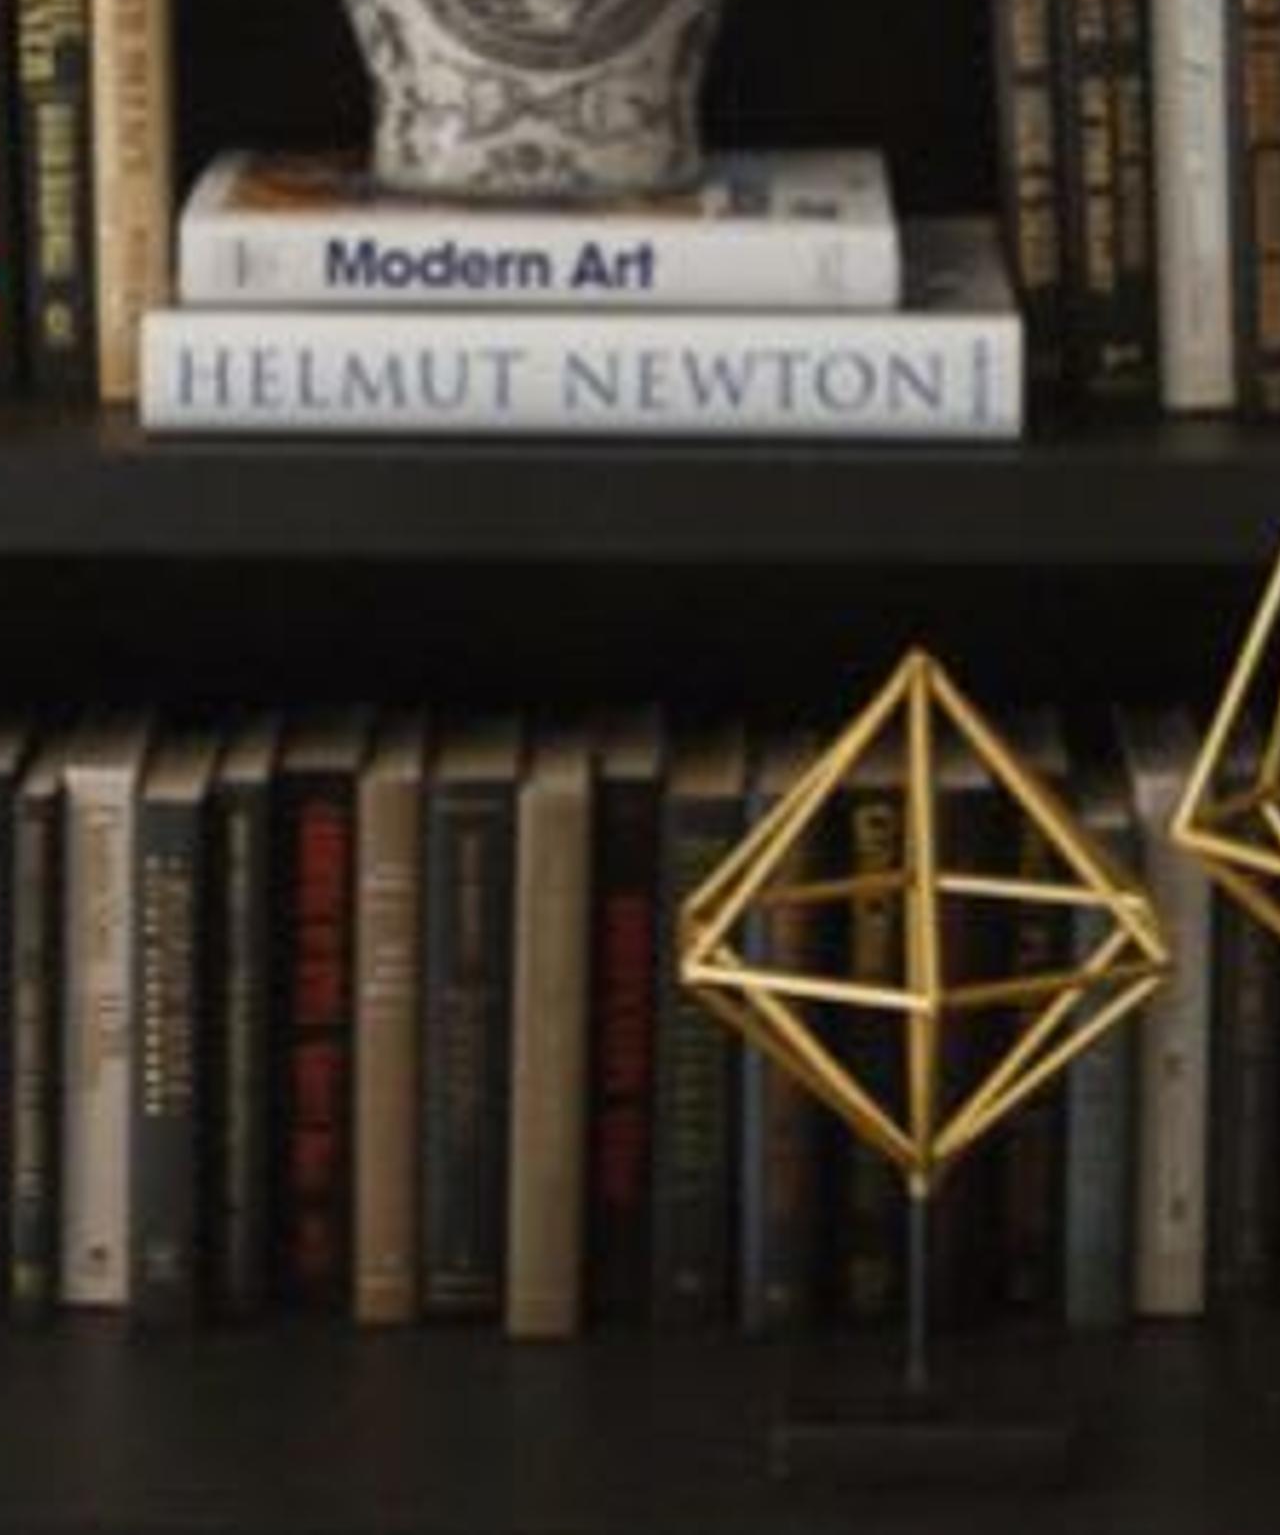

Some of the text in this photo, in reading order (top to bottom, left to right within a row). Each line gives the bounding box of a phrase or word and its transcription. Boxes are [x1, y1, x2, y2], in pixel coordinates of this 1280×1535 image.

[324, 238, 655, 290] Modern Art
[177, 347, 522, 410] HELMUT
[561, 347, 943, 410] NEWTON
